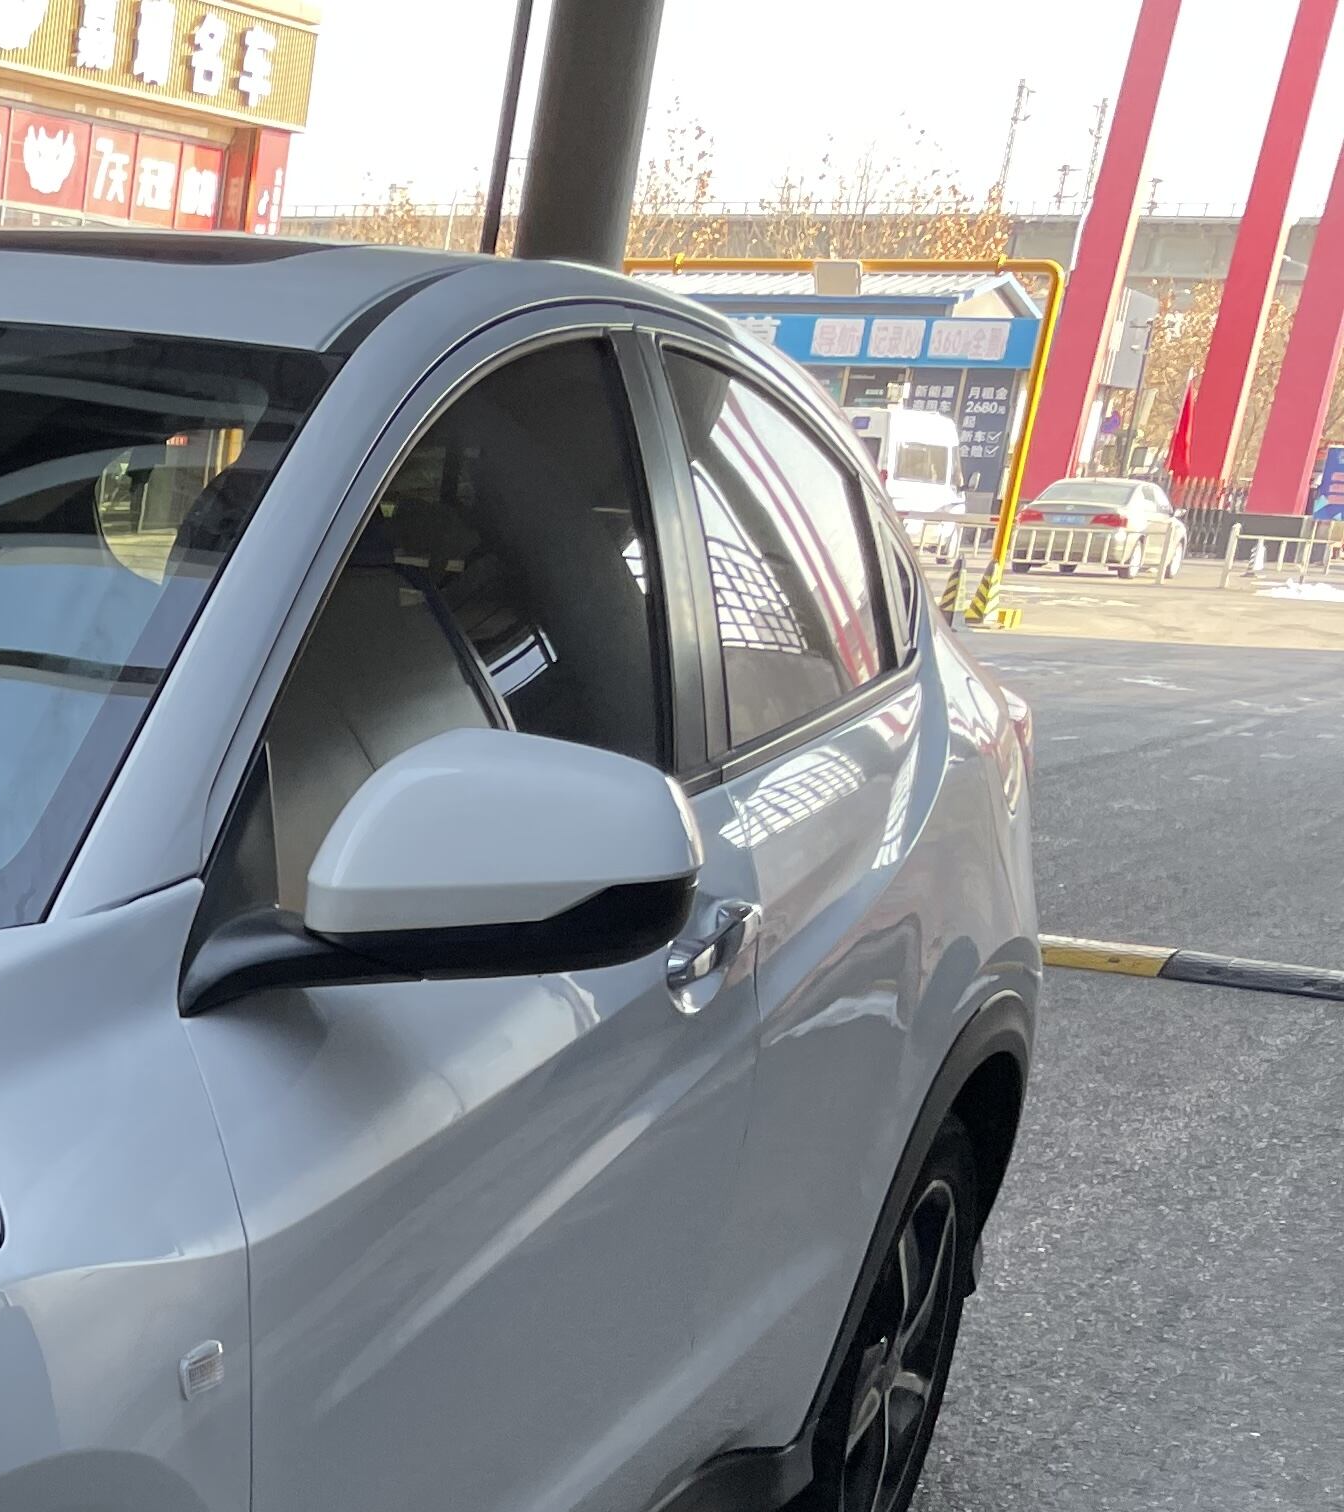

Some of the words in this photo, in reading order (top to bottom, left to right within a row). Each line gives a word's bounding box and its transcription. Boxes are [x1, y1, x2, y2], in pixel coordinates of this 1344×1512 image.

[968, 386, 1009, 400] 月租金
[959, 430, 986, 443] 新车
